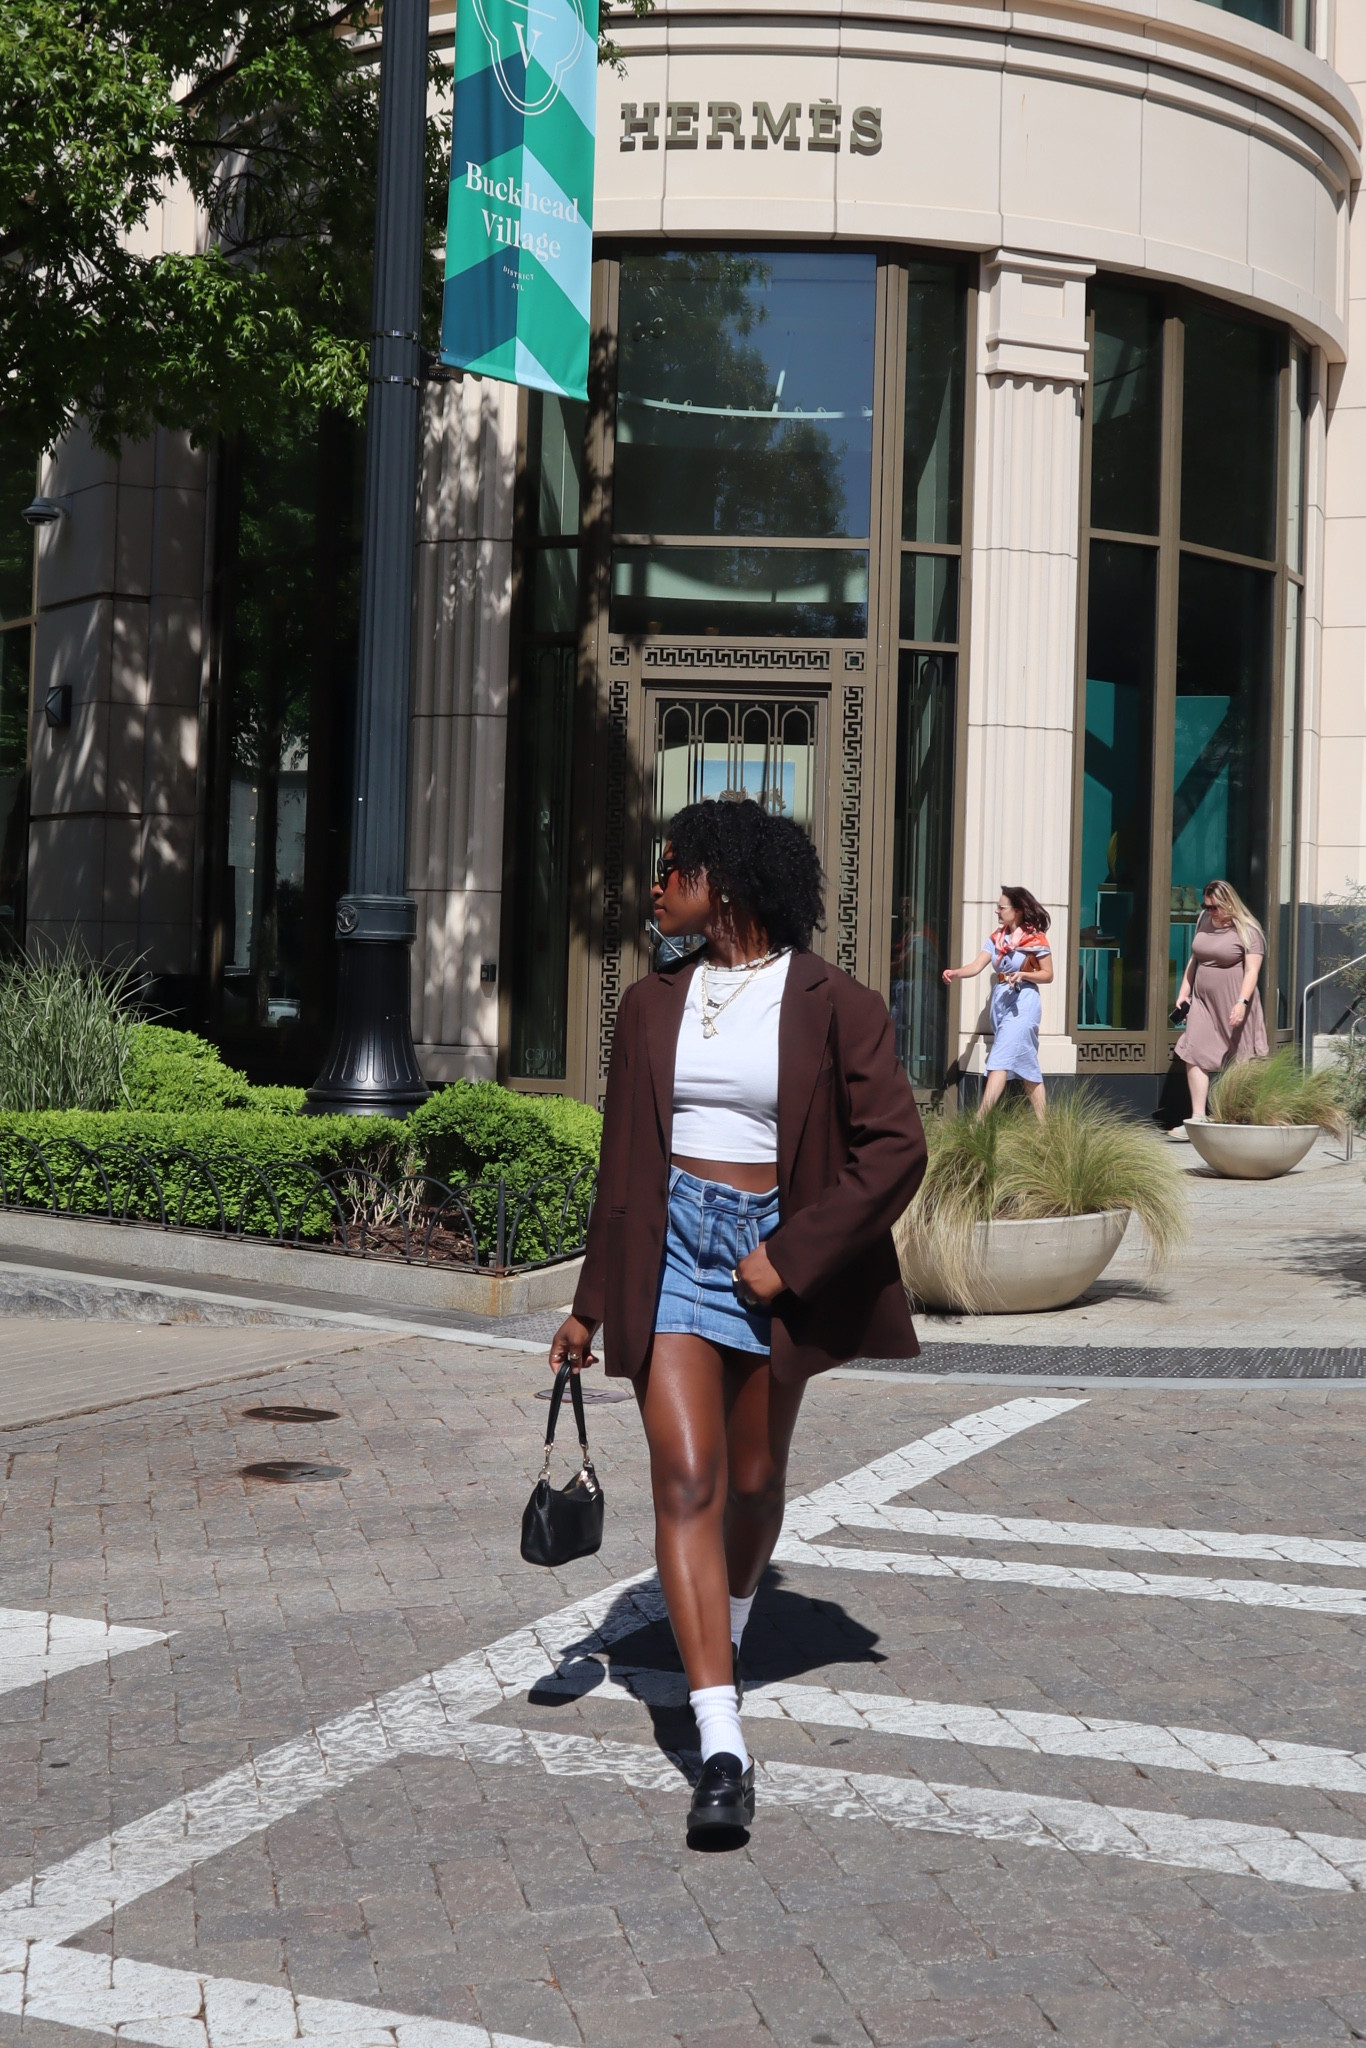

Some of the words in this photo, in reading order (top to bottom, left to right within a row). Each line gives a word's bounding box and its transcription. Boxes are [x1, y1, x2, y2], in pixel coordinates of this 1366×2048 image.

[512, 21, 543, 69] V
[620, 98, 882, 155] HERMÈS
[465, 161, 578, 224] Buckhead
[481, 208, 561, 262] Village
[502, 265, 535, 280] DISTRICT
[511, 282, 524, 291] ATL
[525, 1047, 557, 1061] C300
